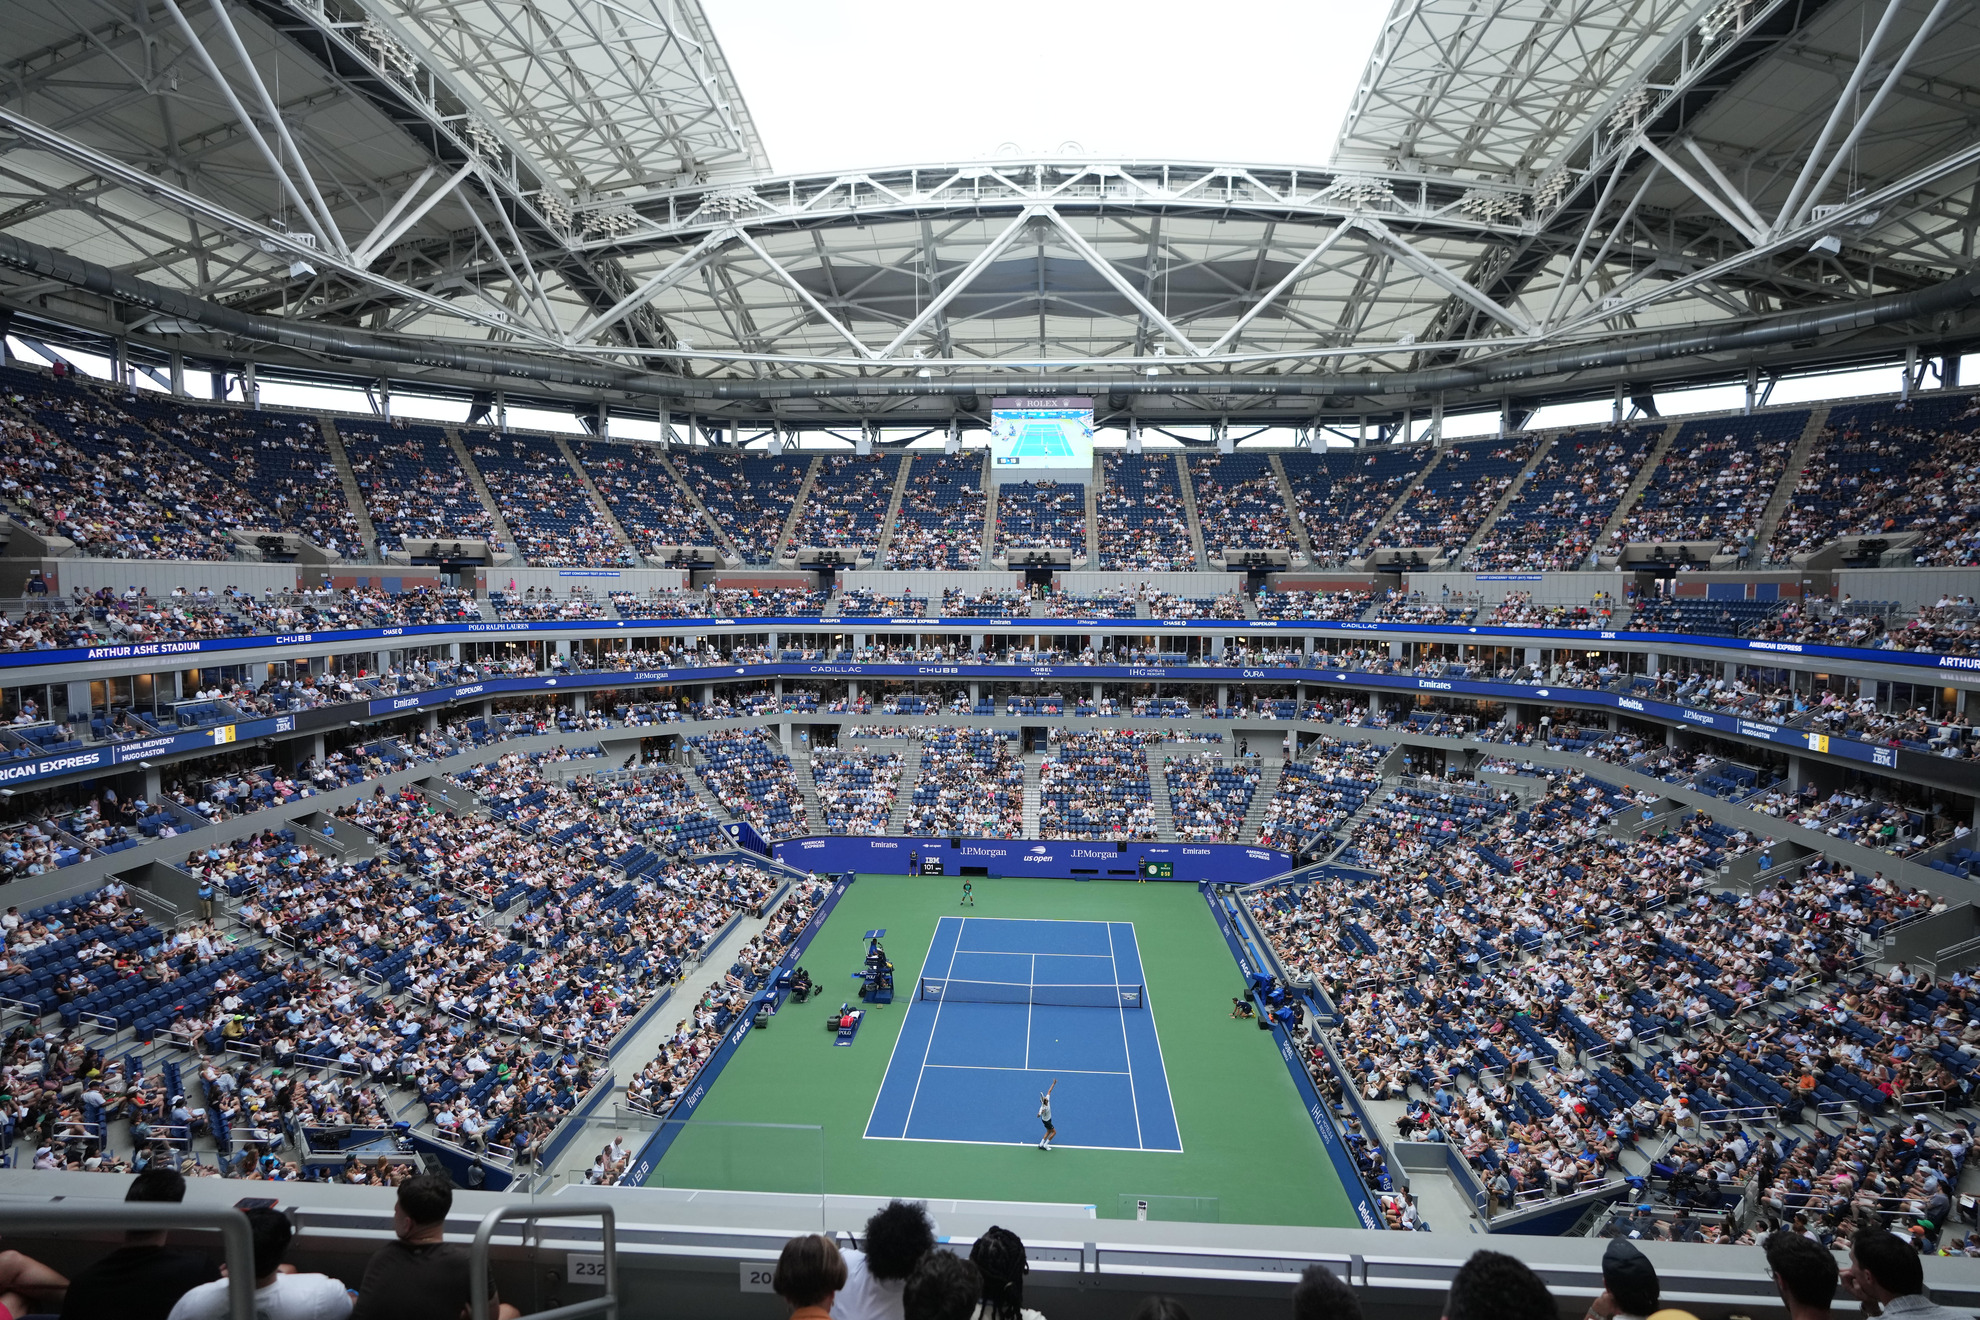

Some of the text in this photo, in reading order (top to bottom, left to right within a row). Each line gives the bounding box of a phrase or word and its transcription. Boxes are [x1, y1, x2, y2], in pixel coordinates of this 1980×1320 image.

[276, 634, 312, 644] CHUBB
[88, 641, 200, 659] ARTHUR ASHE STADIUM
[1749, 641, 1802, 652] AMERICAN EXPRESS
[1939, 656, 1980, 669] ARTHUR
[634, 672, 668, 680] J.P.Morgan
[455, 684, 483, 697] USOPEN.ORG
[1419, 680, 1451, 690] Emirates
[393, 696, 419, 709] Emirates
[1619, 697, 1644, 711] Deloitte.
[1682, 710, 1714, 724] J.P.Morgan
[276, 722, 291, 733] IBM
[1755, 723, 1778, 733] MEDVEDEV
[1742, 729, 1771, 740] HUGO GASTON
[121, 742, 142, 752] DANIIL
[142, 737, 175, 749] MEDVEDEV
[122, 748, 165, 761] HUGO GASTON
[1873, 753, 1891, 766] IBM
[40, 753, 100, 773] EXPRESS
[960, 847, 1007, 857] J.P.Morgan
[1071, 850, 1118, 860] J.P.Morgan
[1249, 853, 1270, 861] EXPRESS
[1240, 958, 1251, 978] FAGE
[732, 1018, 751, 1045] FAGE
[1283, 1040, 1294, 1060] DOBEL
[685, 1084, 705, 1108] Harvey
[1311, 1103, 1324, 1125] IHG
[1358, 1200, 1376, 1230] Deloitt
[576, 1263, 605, 1276] 232
[751, 1271, 772, 1284] 20
